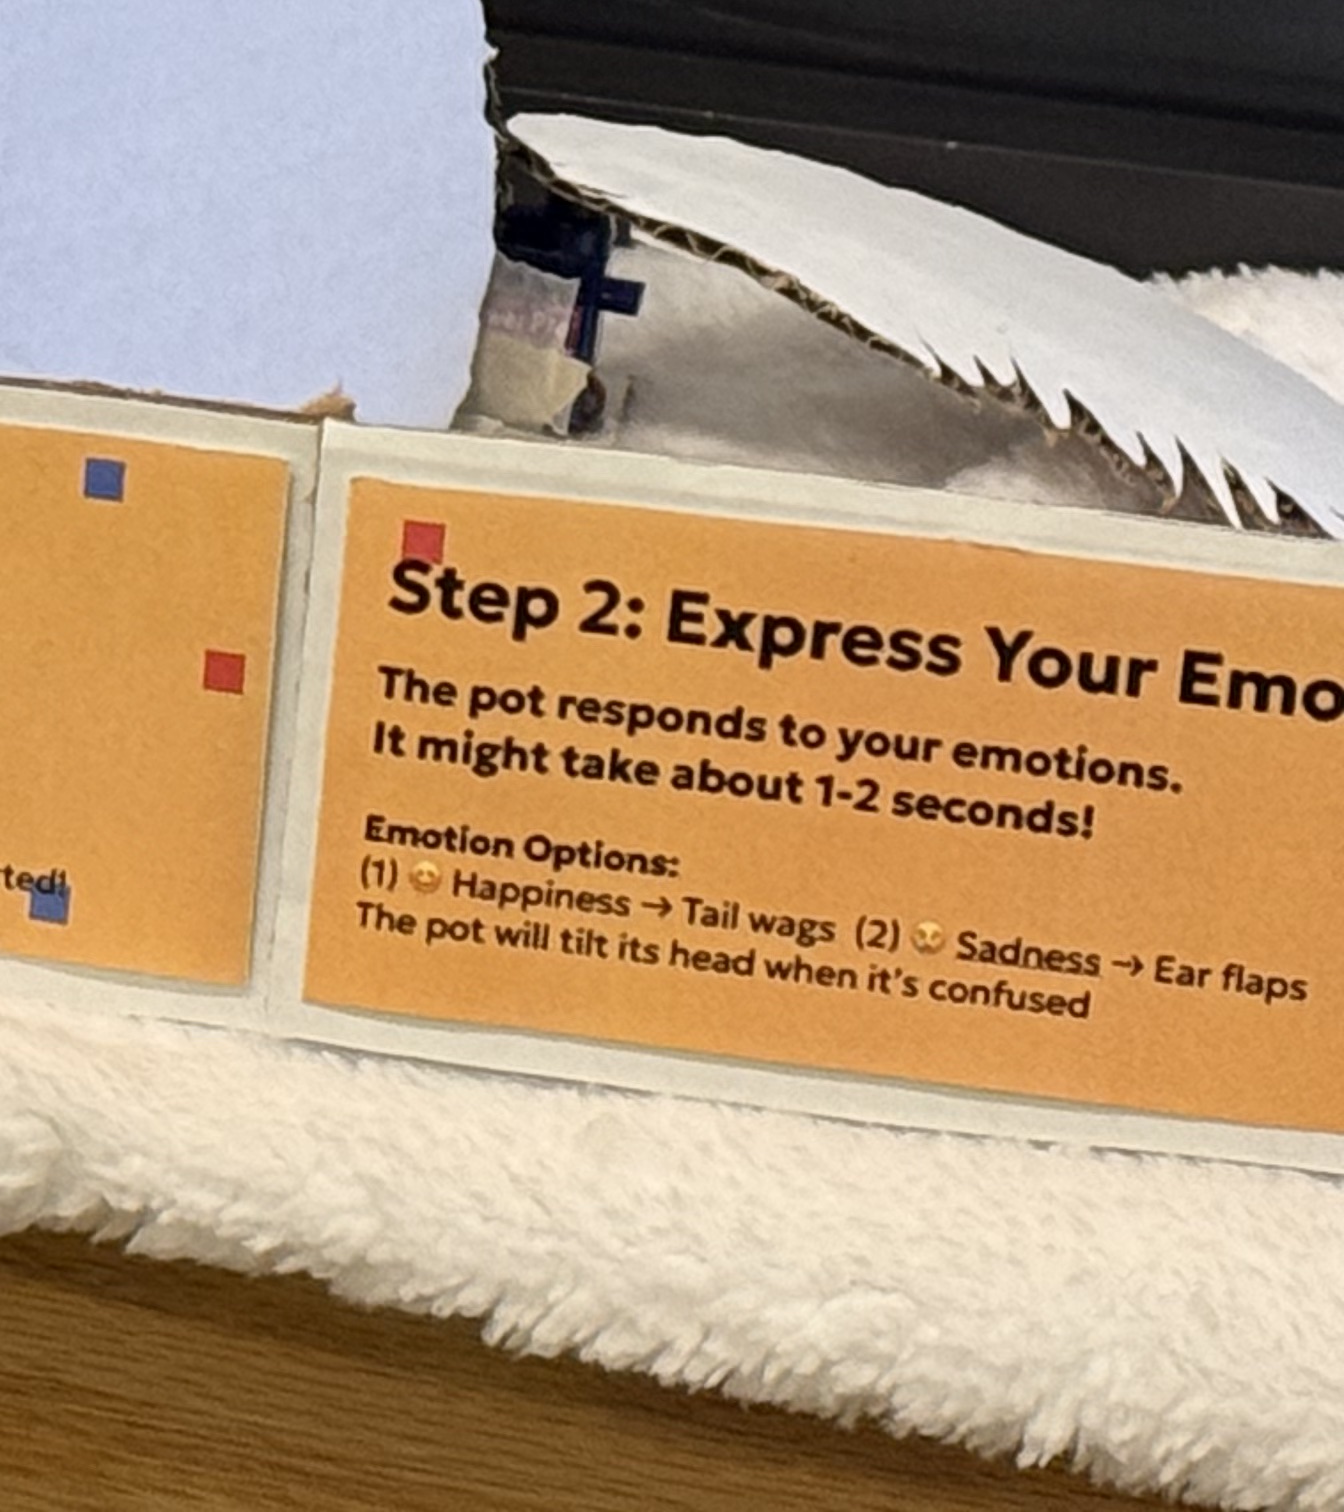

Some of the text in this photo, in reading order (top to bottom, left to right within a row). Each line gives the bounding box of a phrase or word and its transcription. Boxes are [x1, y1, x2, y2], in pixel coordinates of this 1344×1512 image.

[389, 558, 1344, 722] Step 2: Express Your Emo
[374, 721, 1094, 839] It might take about 1-2 seconds!
[378, 666, 1182, 793] The pot responds to your emotions.
[365, 814, 679, 878] Emotion Options:
[357, 901, 1090, 1018] The pot will tilt its head when it's confused
[362, 856, 1307, 1004] (1) Happiness Tail wags (2) Sadness Ear flaps
